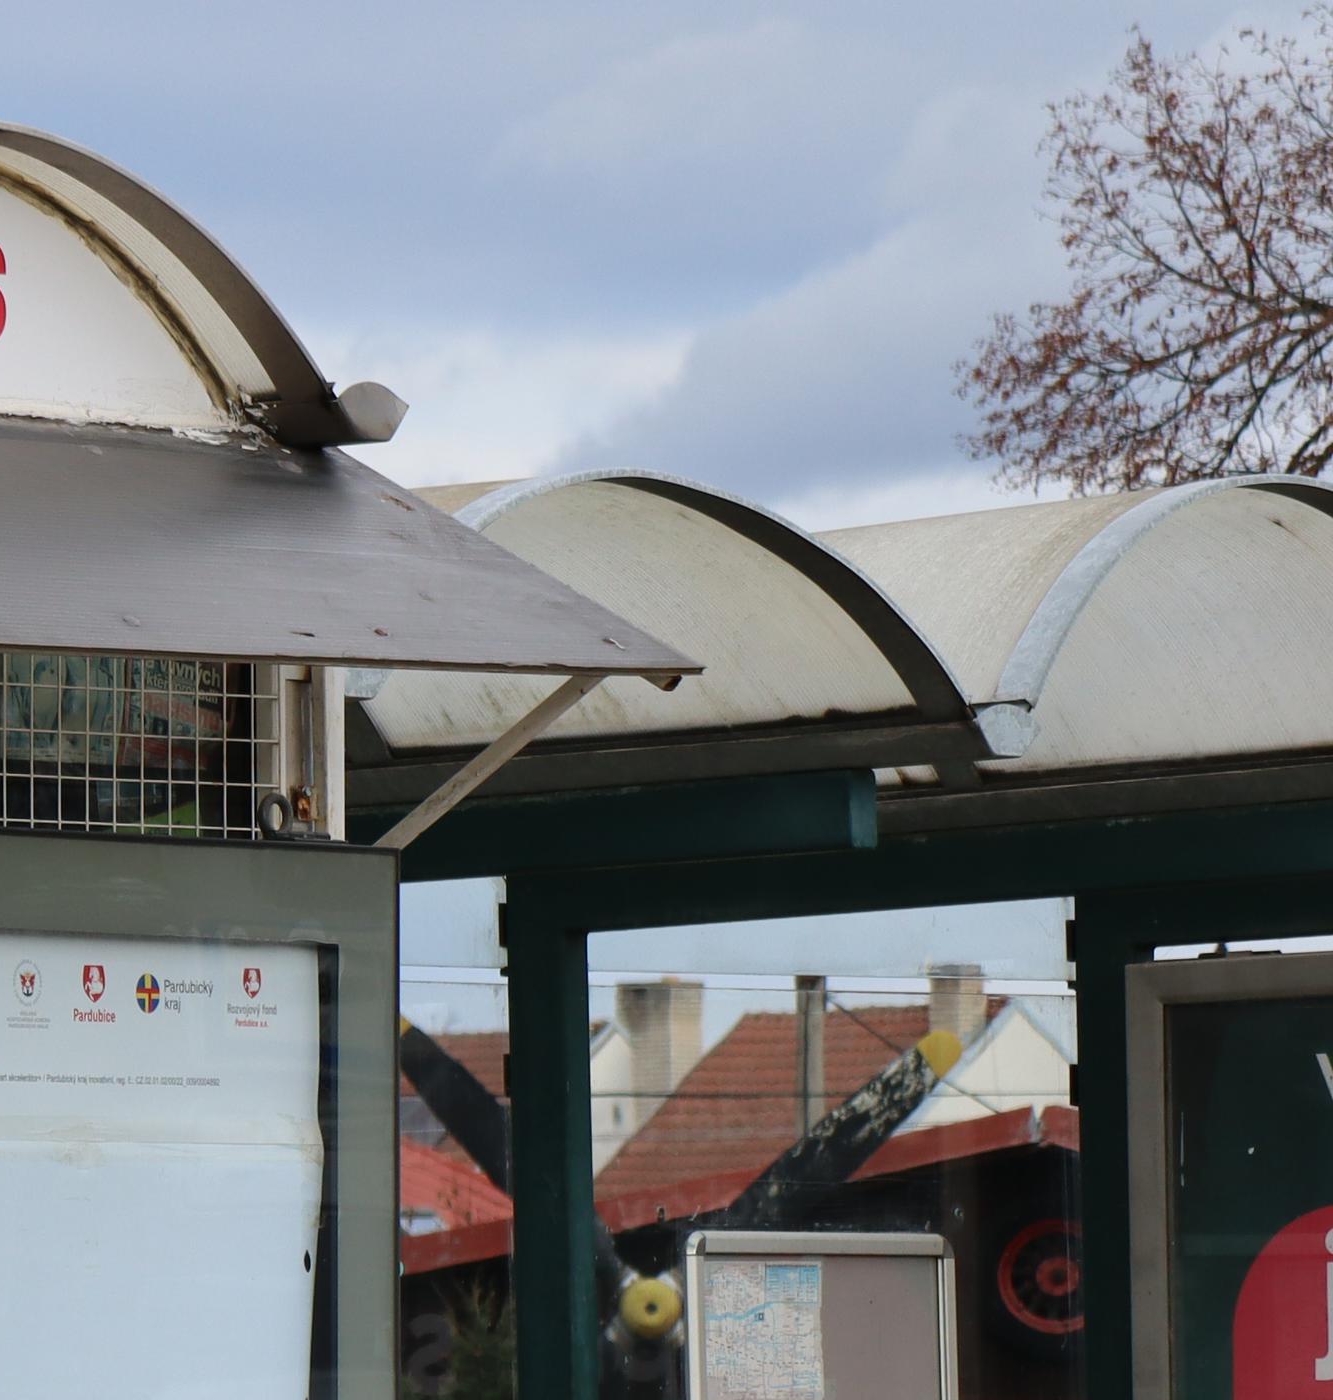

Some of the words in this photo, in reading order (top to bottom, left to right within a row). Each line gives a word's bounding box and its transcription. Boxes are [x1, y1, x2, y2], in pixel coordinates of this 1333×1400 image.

[164, 980, 214, 997] Pardubický
[164, 998, 181, 1013] kraj
[73, 1008, 116, 1022] Pardubice
